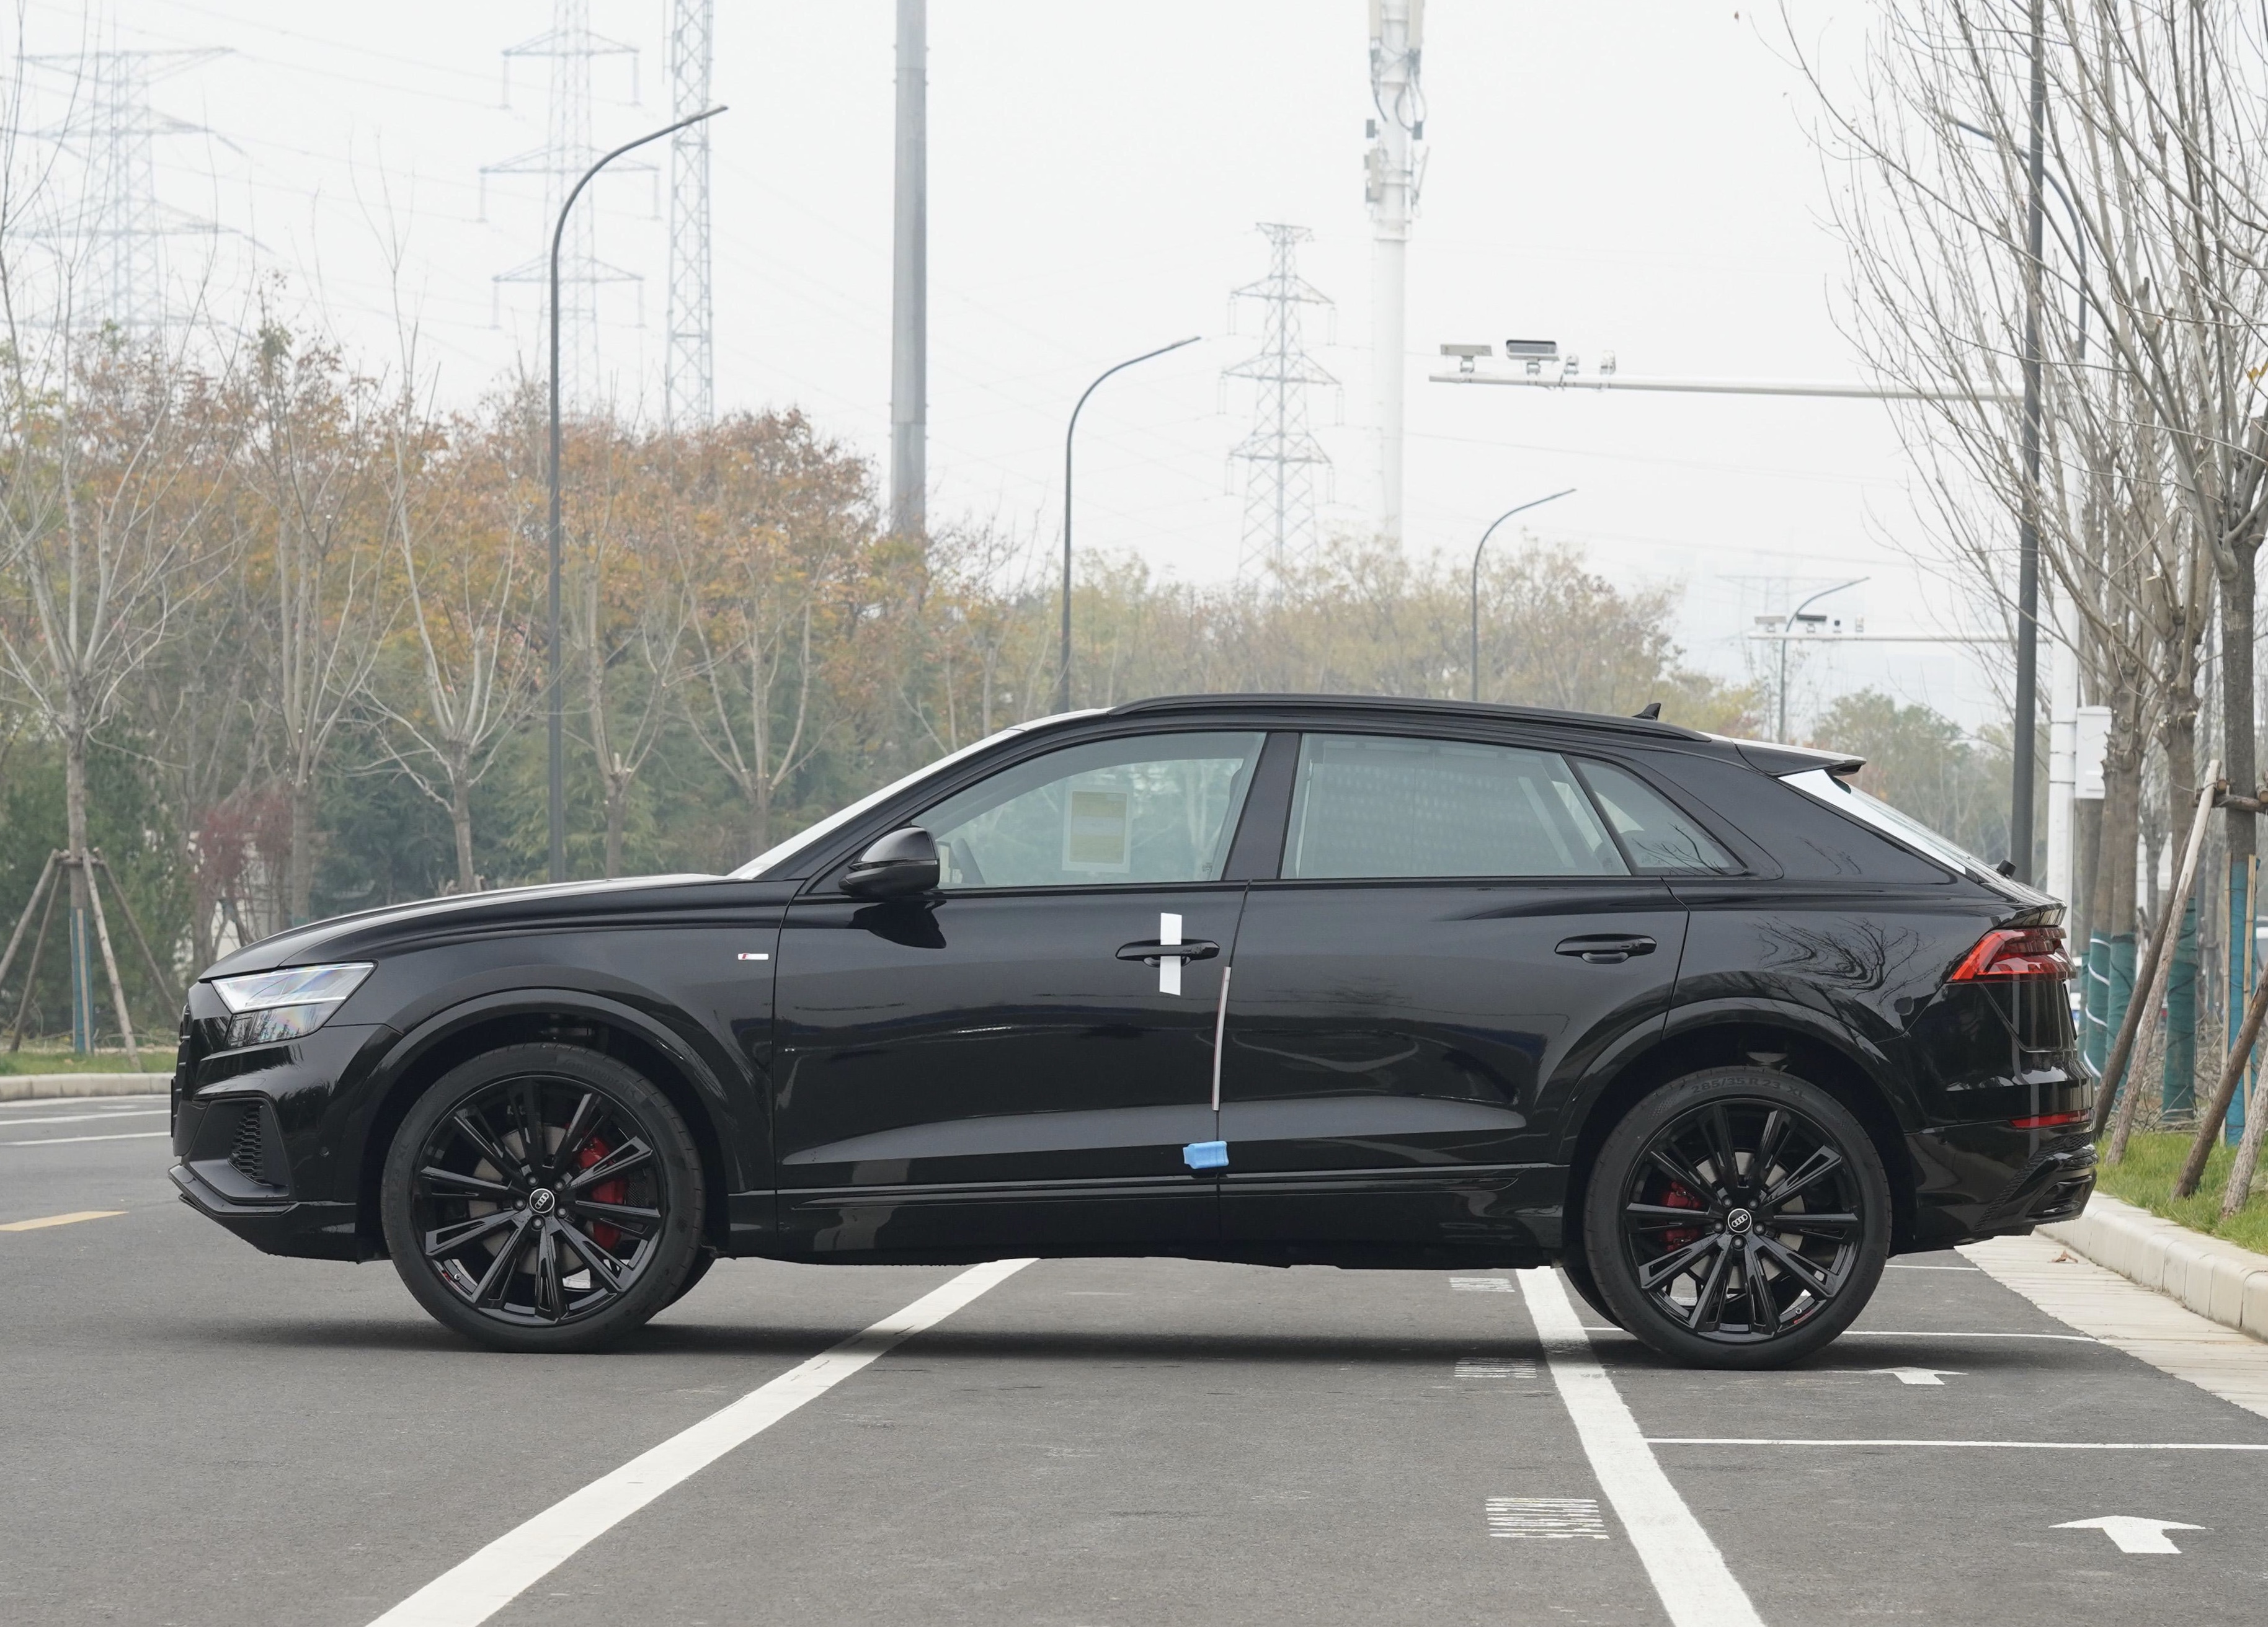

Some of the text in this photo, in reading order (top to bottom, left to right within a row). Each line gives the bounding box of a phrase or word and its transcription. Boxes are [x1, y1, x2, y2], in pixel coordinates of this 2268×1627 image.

[1691, 1077, 1745, 1093] 285/35
[1748, 1078, 1759, 1086] R
[1762, 1079, 1781, 1089] 23
